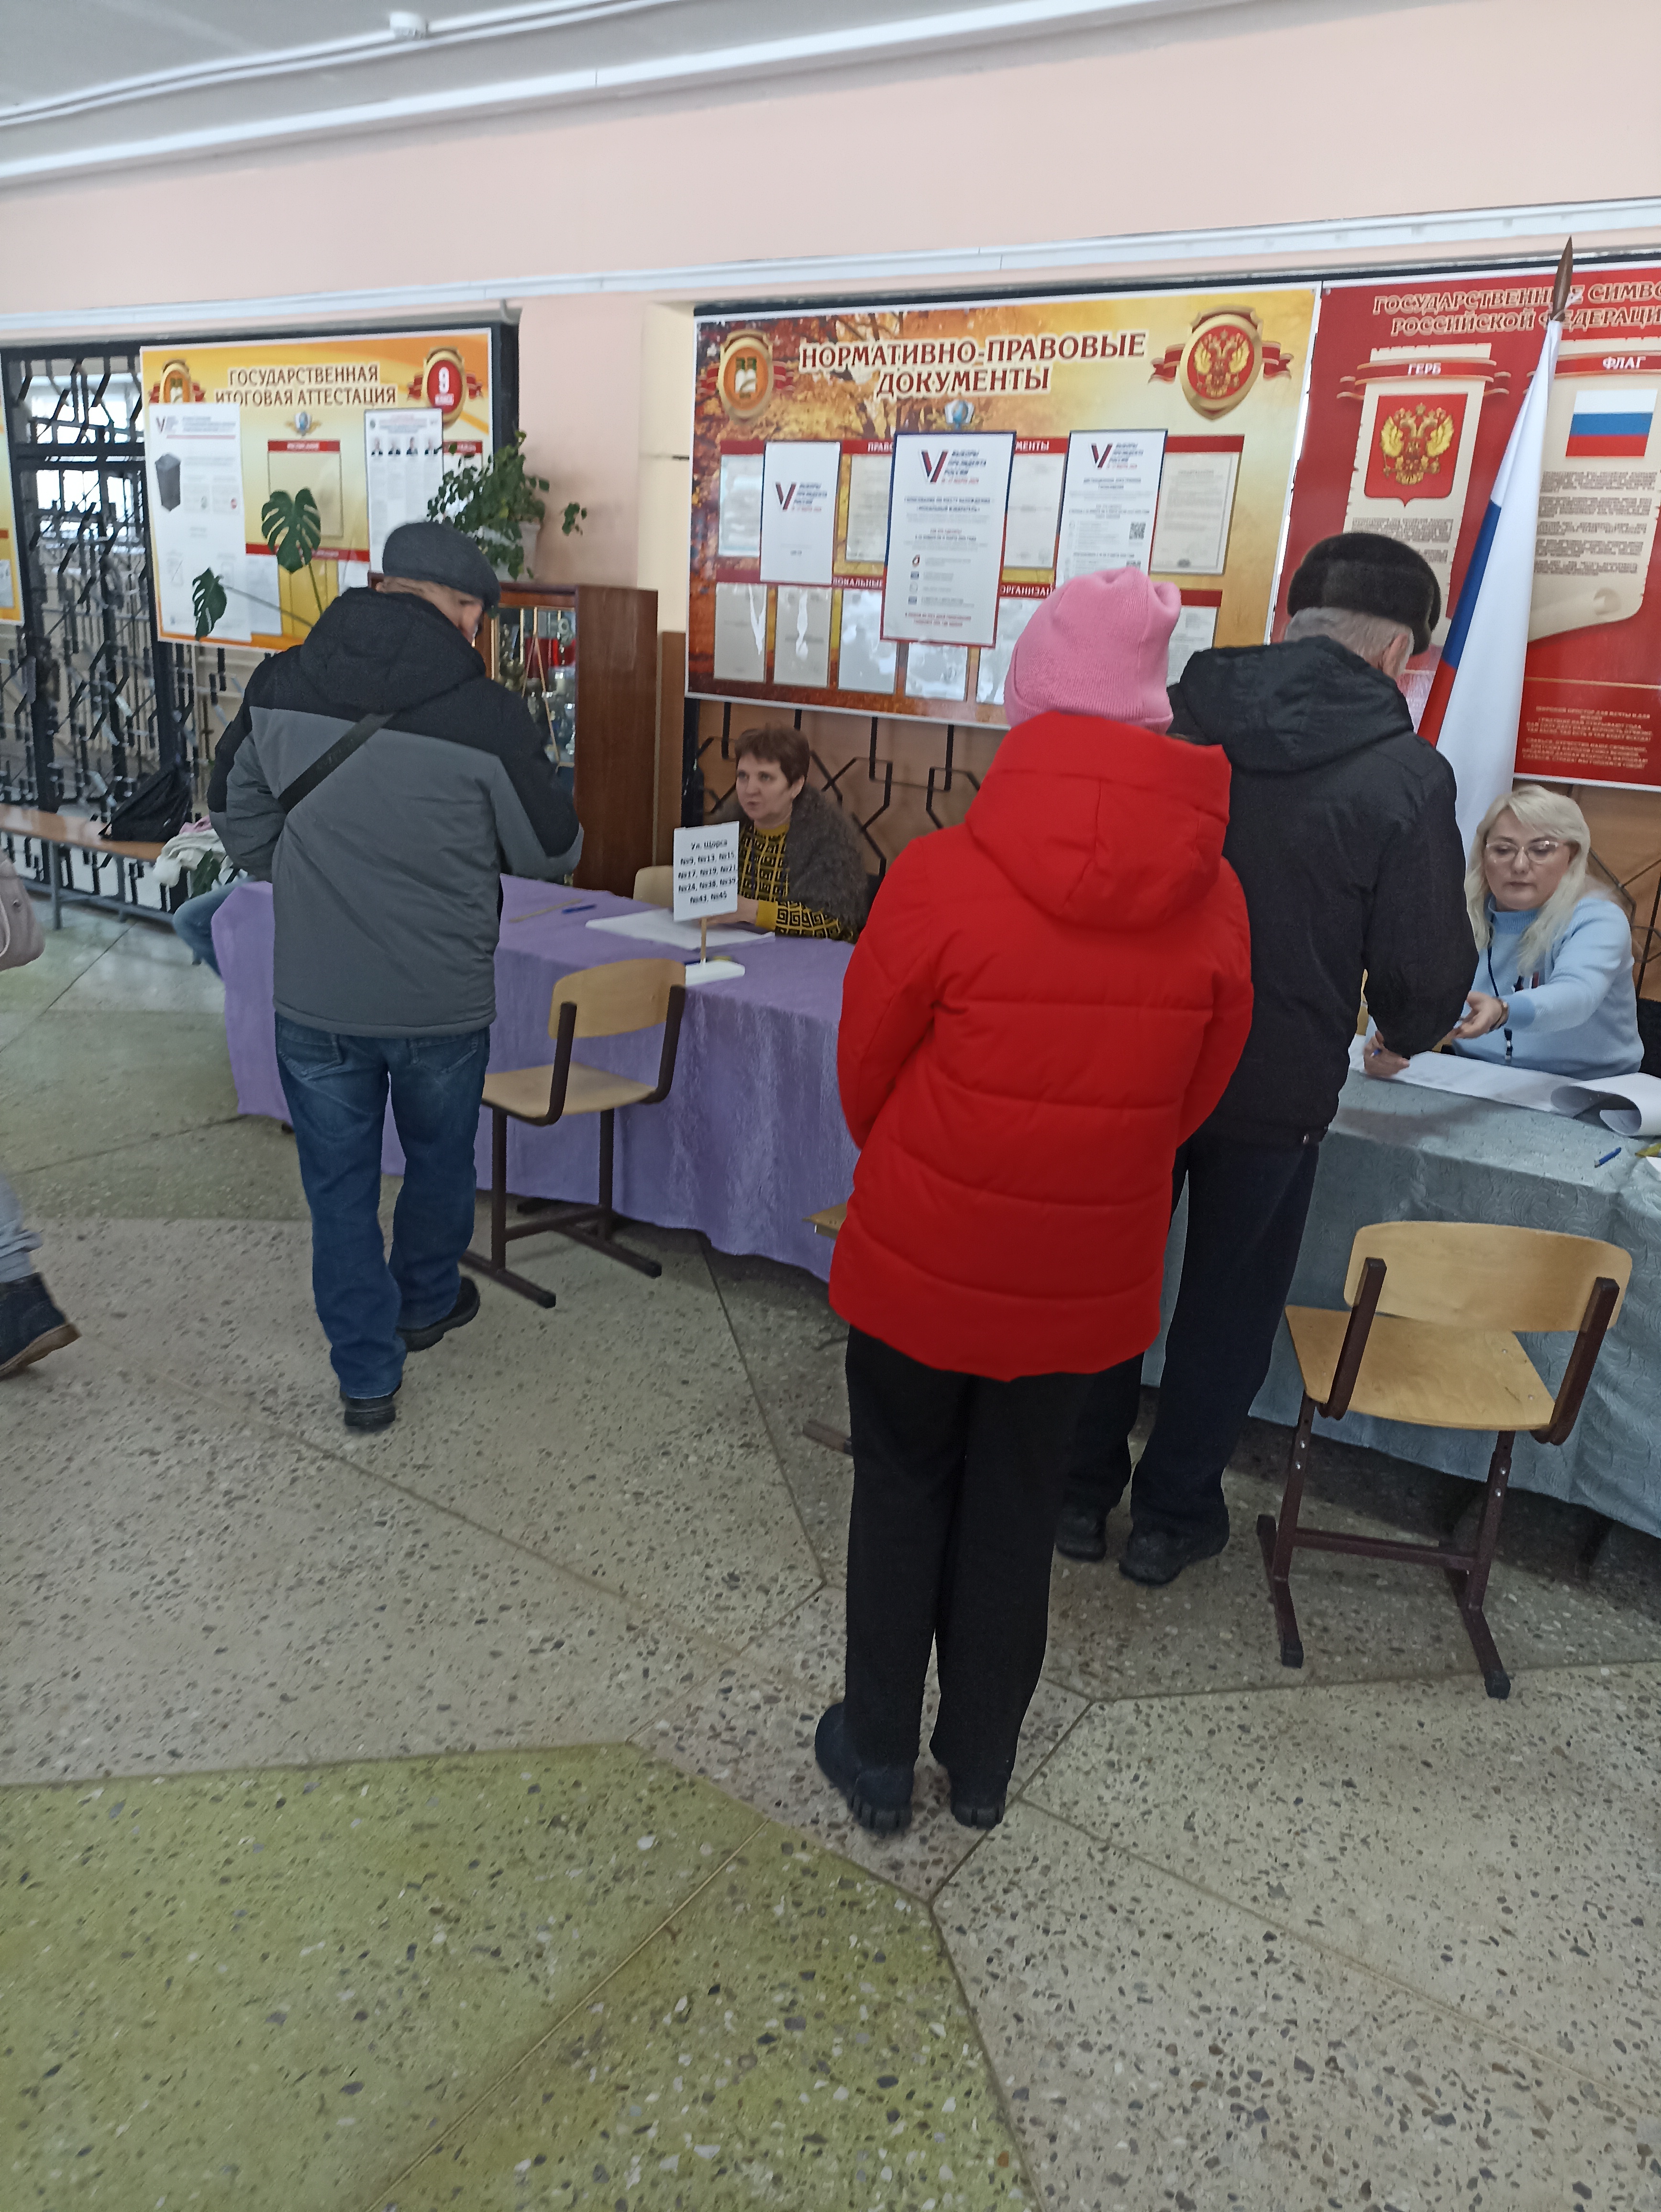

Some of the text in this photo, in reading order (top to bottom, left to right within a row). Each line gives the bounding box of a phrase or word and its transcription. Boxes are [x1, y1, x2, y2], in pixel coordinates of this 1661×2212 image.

[1391, 308, 1536, 336] РОССИЙСКОЙ
[801, 332, 1146, 368] НОРМАТИВНО-ПРАВОВЫЕ
[1407, 363, 1441, 375] ГЕРБ
[1603, 356, 1646, 369] ФЛАГ
[230, 364, 378, 386] ГОСУДАРСТВЕННАЯ
[876, 366, 1050, 398] ДОКУМЕНТЫ
[215, 386, 396, 408] ИТОГОВАЯ АТТЕСТАЦИЯ
[678, 869, 698, 879] №17,
